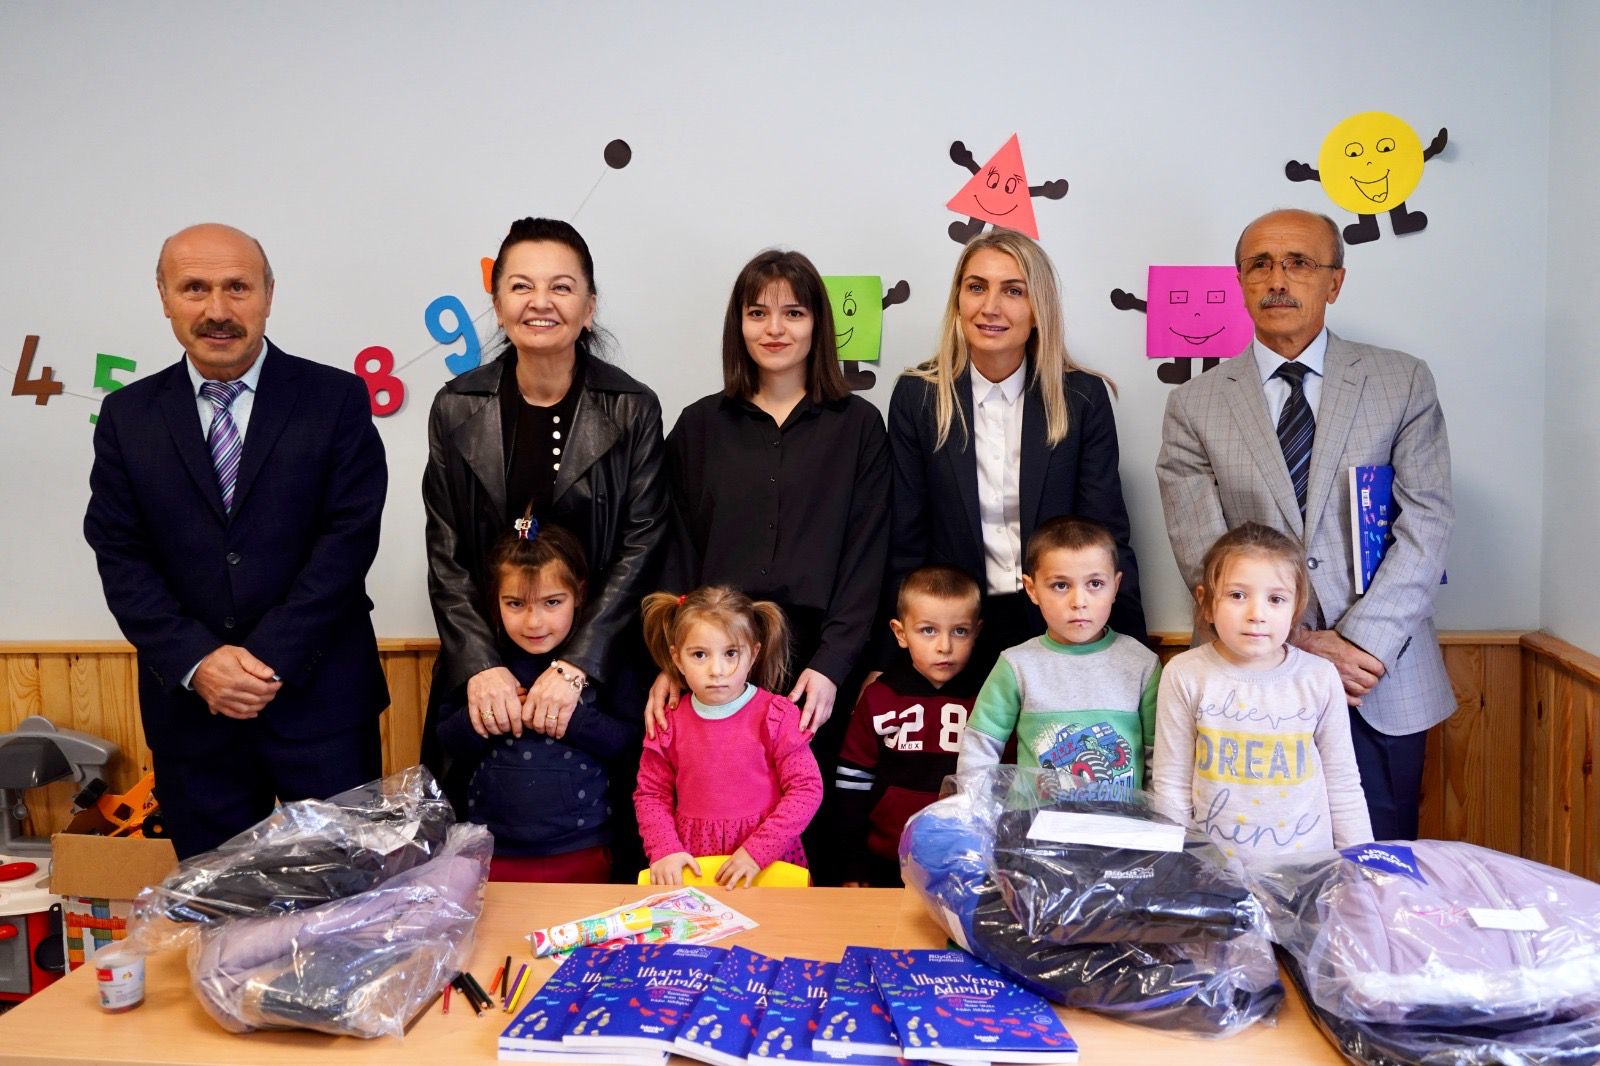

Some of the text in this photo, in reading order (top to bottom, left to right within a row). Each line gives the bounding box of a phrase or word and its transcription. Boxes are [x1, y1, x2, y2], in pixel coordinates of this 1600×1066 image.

[12, 335, 63, 406] 4
[354, 346, 405, 416] 8
[425, 295, 481, 376] 9
[1193, 788, 1321, 848] hine
[961, 974, 1006, 988] Veren
